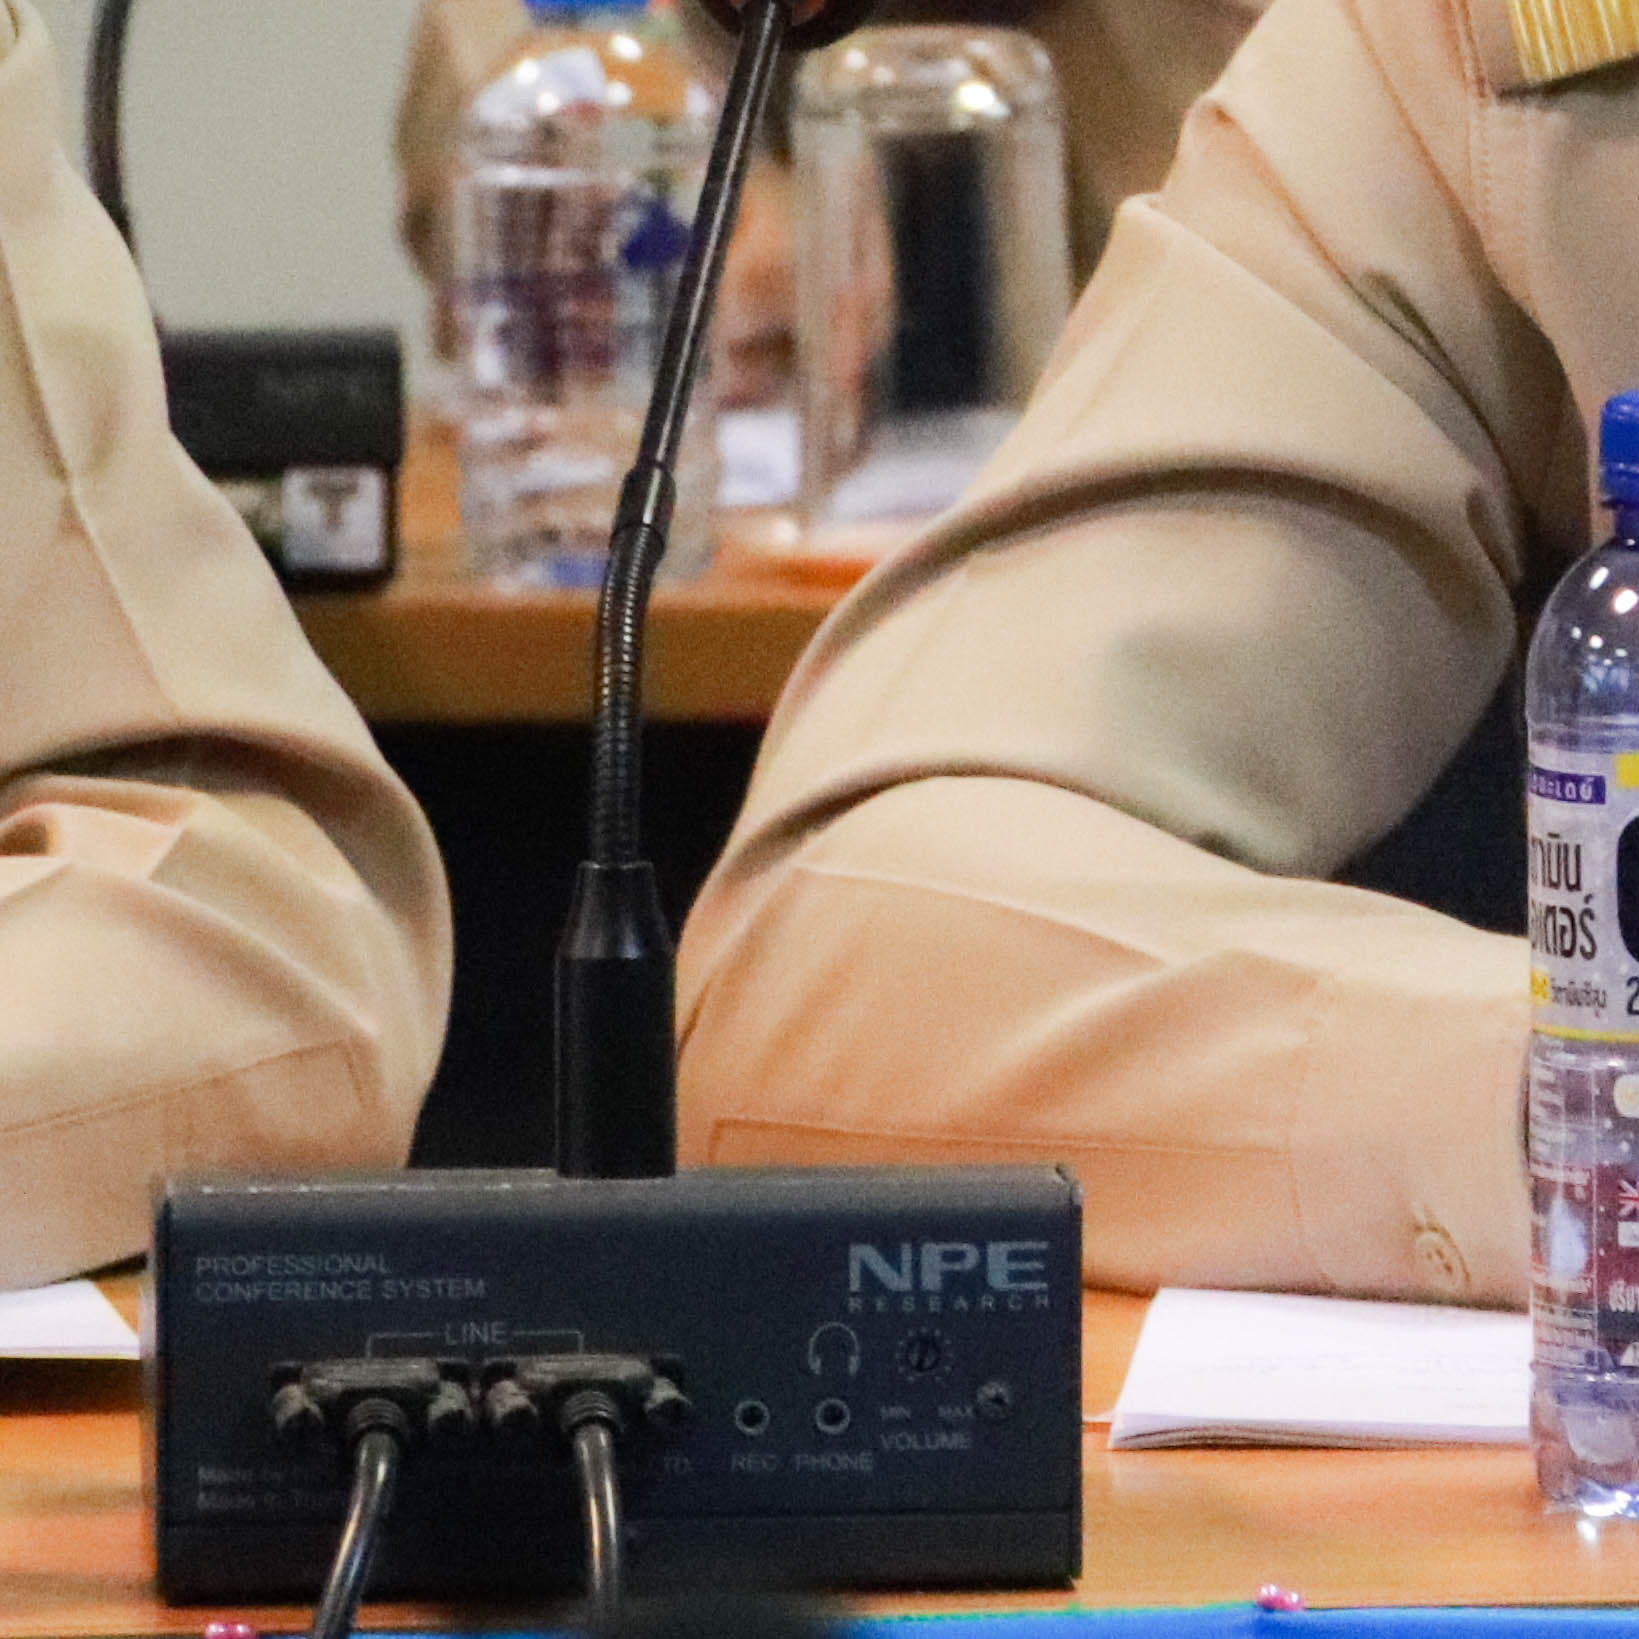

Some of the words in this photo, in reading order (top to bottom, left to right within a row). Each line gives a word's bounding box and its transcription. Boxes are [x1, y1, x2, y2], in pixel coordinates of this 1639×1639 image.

[195, 1253, 391, 1277] PROFESSIONAL
[848, 1240, 1050, 1293] NPE
[195, 1279, 372, 1303] CONFERENCE
[381, 1277, 486, 1300] SYSTEM
[848, 1294, 1051, 1314] RESEARCH
[445, 1321, 510, 1345] LINE
[880, 1404, 912, 1420] MIN
[880, 1430, 973, 1452] VOLUME
[794, 1449, 875, 1474] PHONE
